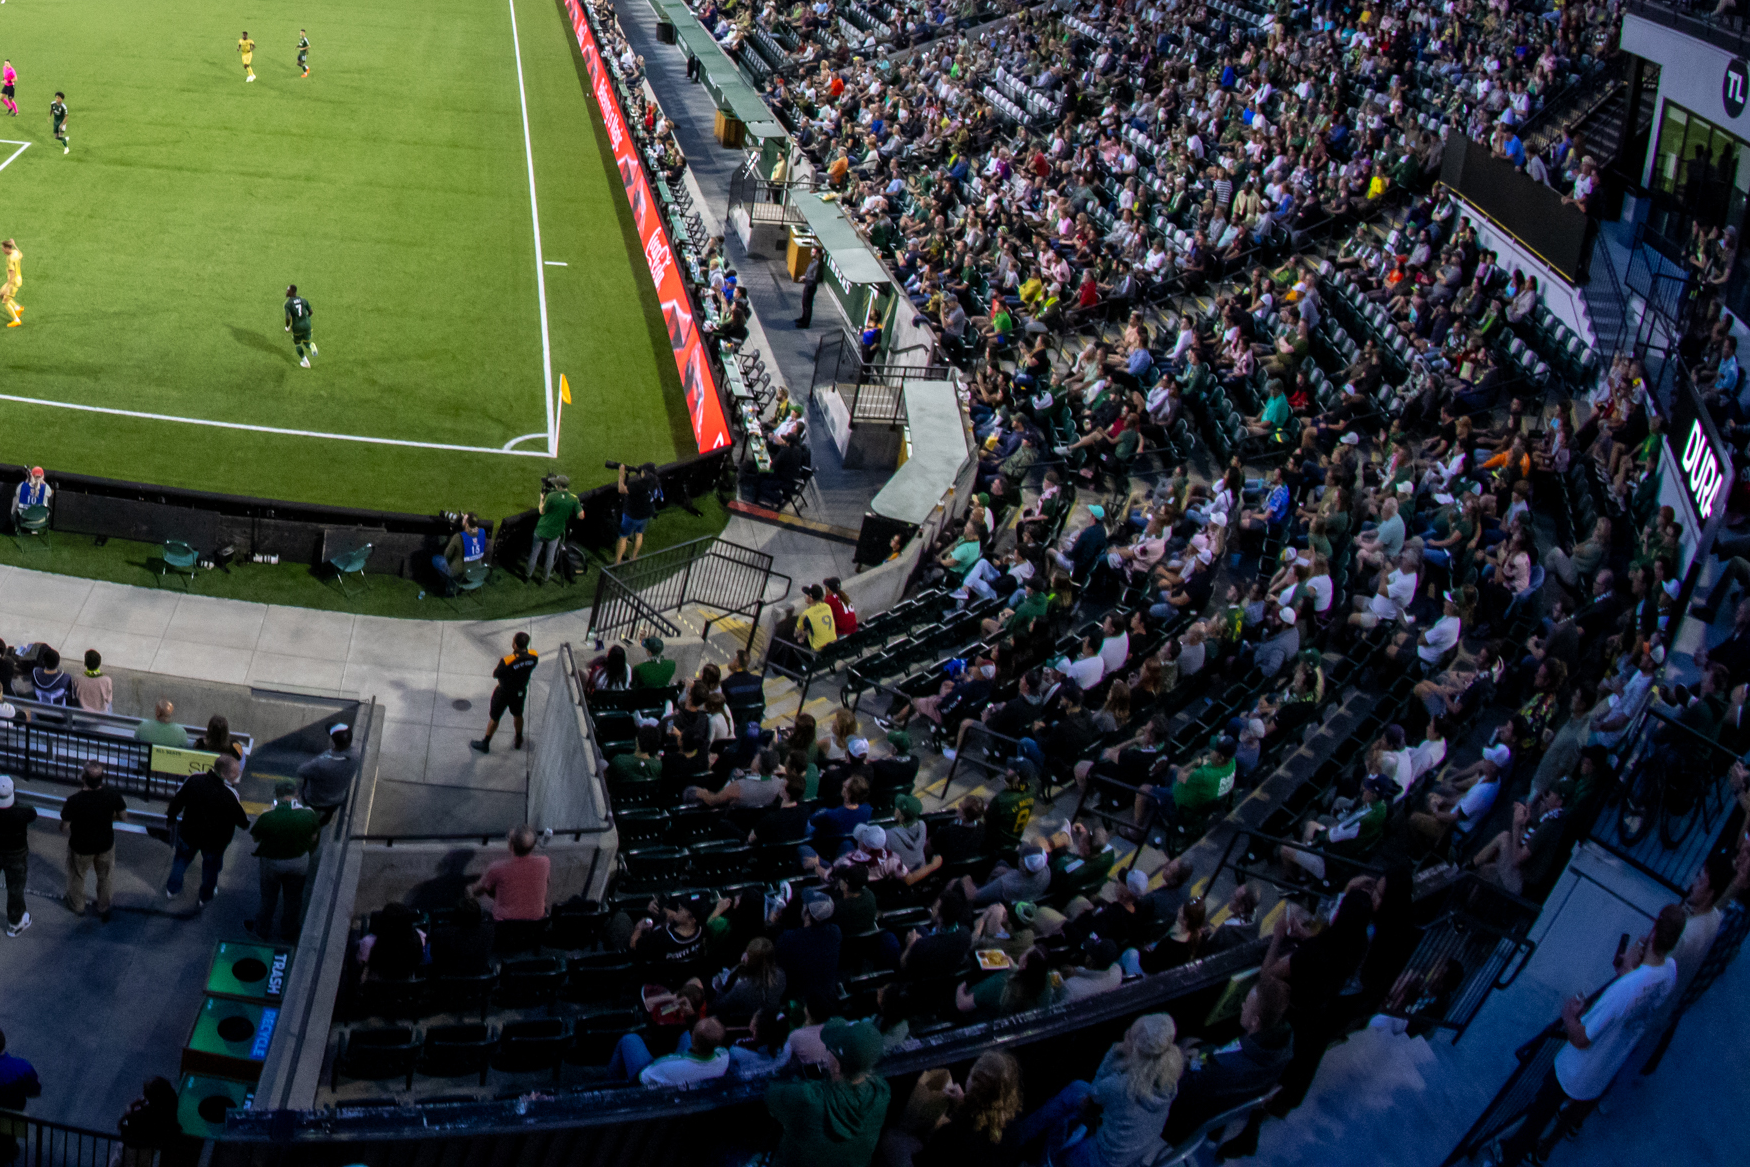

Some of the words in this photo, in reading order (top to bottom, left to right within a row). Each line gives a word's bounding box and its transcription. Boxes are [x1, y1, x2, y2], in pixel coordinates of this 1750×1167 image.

[1727, 70, 1745, 104] TL
[265, 952, 287, 995] TRASH
[253, 1009, 279, 1058] RECYCLE
